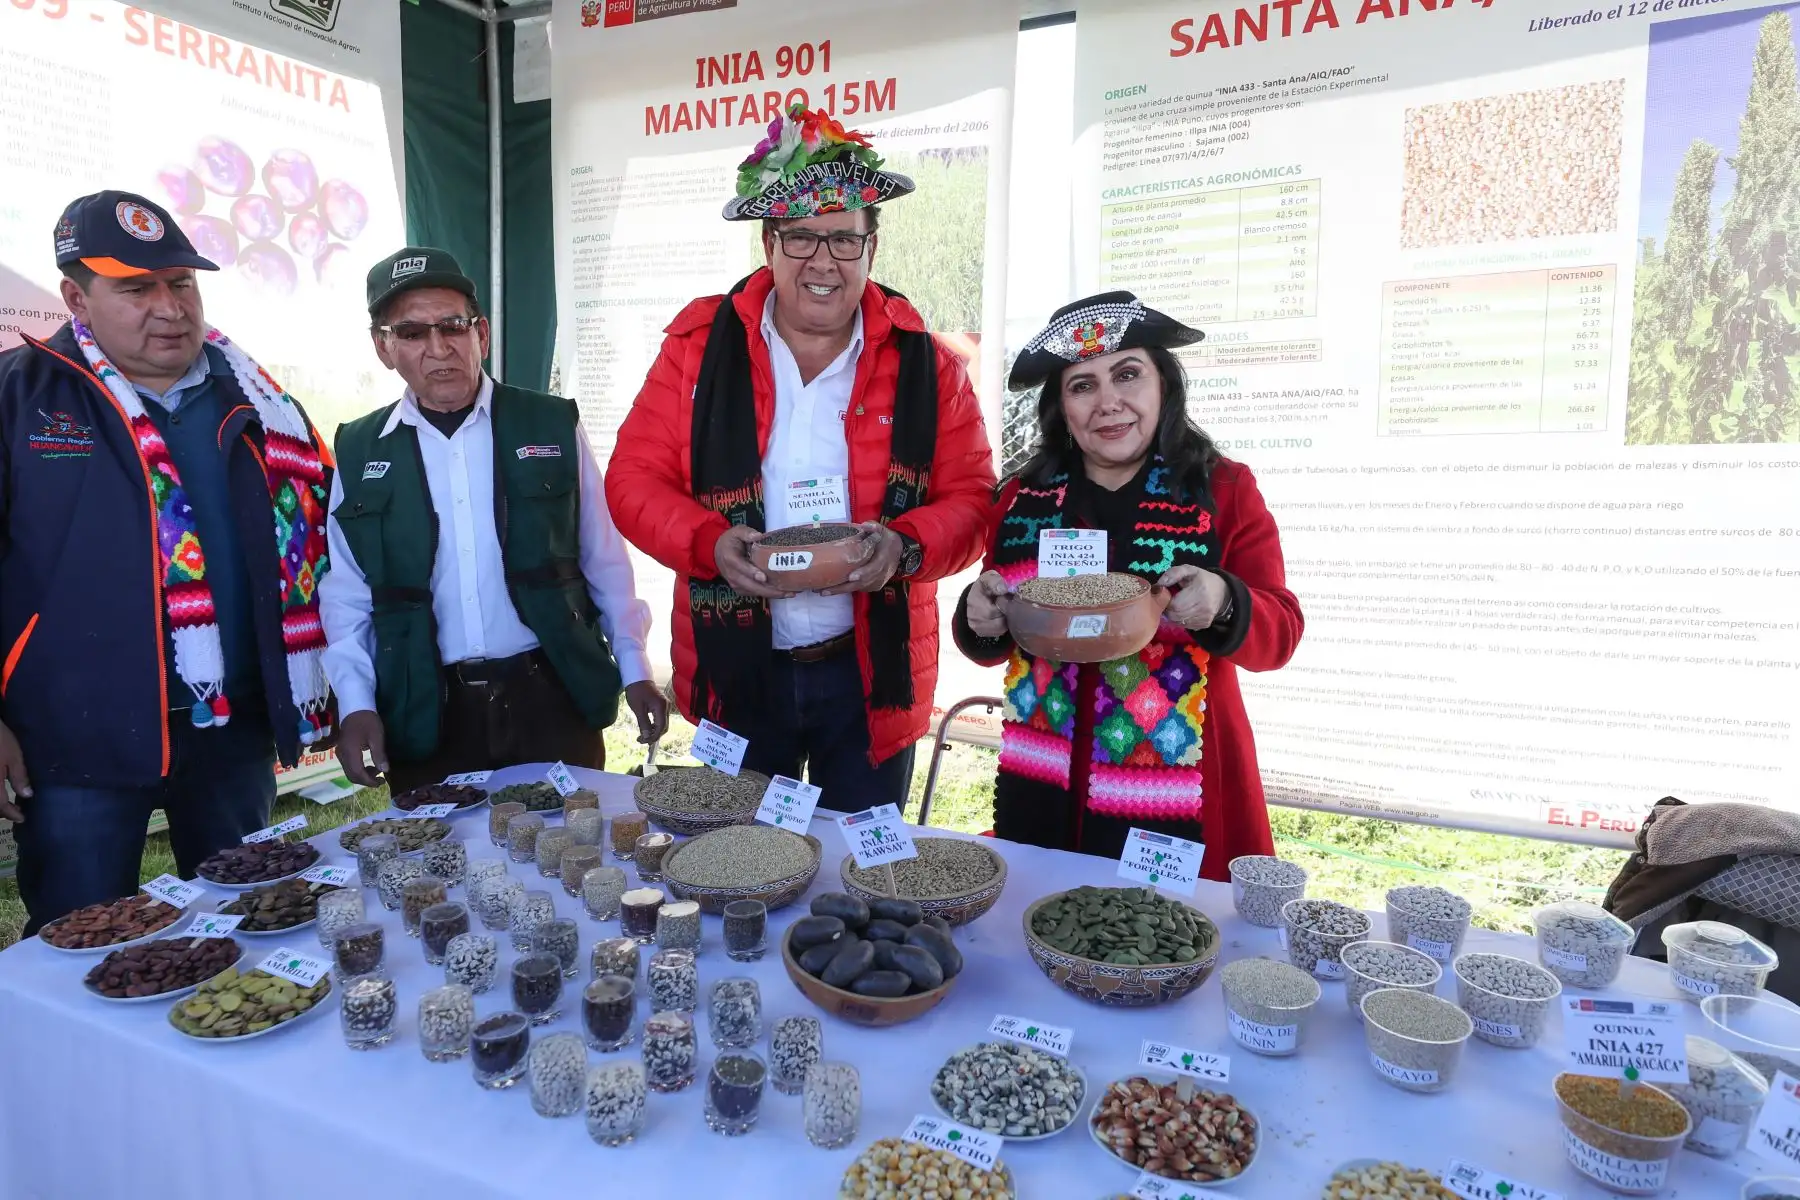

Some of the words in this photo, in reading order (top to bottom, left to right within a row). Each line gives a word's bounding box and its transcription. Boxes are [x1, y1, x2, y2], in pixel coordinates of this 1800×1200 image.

[637, 6, 648, 16] de
[649, 1, 691, 14] Agricultura
[1529, 9, 1603, 32] Liberado
[1607, 5, 1621, 20] el
[1626, 1, 1649, 17] 12
[1653, 0, 1674, 12] de
[263, 10, 293, 28] Nacional
[293, 23, 302, 32] de
[303, 26, 338, 46] Innovación
[338, 39, 361, 54] Agraria
[1169, 0, 1340, 58] SANTA
[123, 6, 351, 114] SERRANITA
[696, 50, 764, 89] INIA
[775, 40, 832, 79] 901
[1103, 114, 1136, 126] proviene
[1138, 112, 1147, 121] de
[1149, 110, 1164, 118] una
[1166, 106, 1187, 116] cruza
[1188, 102, 1215, 112] simple
[1216, 94, 1266, 108] proveniente
[1268, 91, 1279, 100] de
[1281, 89, 1289, 98] la
[1291, 84, 1327, 96] Estación
[1329, 74, 1389, 90] Experimental
[1104, 83, 1148, 101] ORIGEN
[1114, 103, 1137, 113] nueva
[1138, 96, 1172, 108] variedad
[1173, 95, 1183, 103] de
[1185, 91, 1213, 101] quinua
[1239, 82, 1255, 91] 433
[1262, 78, 1287, 88] Santa
[644, 87, 809, 136] MANTARO
[823, 77, 897, 117] 15M
[876, 128, 889, 139] de
[890, 123, 941, 138] diciembre
[943, 121, 960, 134] del
[961, 120, 990, 133] 2006
[1103, 137, 1143, 148] Progenitor
[1144, 131, 1183, 142] femenino
[1208, 123, 1227, 132] INIA
[1228, 119, 1251, 130] (004)
[1103, 148, 1142, 160] Progenitor
[1144, 142, 1184, 153] masculino
[1195, 136, 1225, 146] Sajama
[1227, 131, 1249, 143] (002)
[571, 165, 594, 176] ORIGEN
[1102, 161, 1137, 171] Pedigree:
[1101, 177, 1203, 199] CARACTERÍSTICAS
[1206, 165, 1302, 184] AGRONÓMICAS
[1243, 226, 1271, 234] Blanco
[1272, 222, 1307, 231] cremoso
[396, 258, 423, 271] inia
[1550, 270, 1603, 281] CONTENIDO
[1394, 282, 1450, 292] COMPONENTE
[0, 307, 16, 316] so
[19, 308, 41, 319] con
[1216, 345, 1278, 354] Moderadamente
[1280, 343, 1316, 351] tolerante
[1216, 356, 1278, 364] Moderadamente
[1280, 353, 1317, 362] Tolerante
[1207, 393, 1225, 401] INIA
[1226, 392, 1242, 400] 433
[1251, 391, 1278, 400] SANTA
[29, 434, 65, 444] Gobierno
[1235, 439, 1254, 449] DEL
[1259, 438, 1312, 448] CULTIVO
[1502, 464, 1548, 472] disminuir
[1552, 462, 1560, 471] la
[1564, 463, 1614, 472] población
[1635, 461, 1677, 470] malezas
[1692, 461, 1742, 469] disminuir
[1747, 459, 1763, 469] los
[792, 490, 835, 499] SEMILLA
[788, 499, 812, 511] VICIA
[812, 496, 842, 509] SATIVA
[1051, 543, 1093, 551] TRIGO
[1050, 552, 1077, 560] INIA
[1078, 552, 1095, 560] 424
[705, 736, 733, 753] AVENA
[774, 792, 802, 807] QUUA
[860, 824, 891, 838] PAPA
[861, 836, 884, 850] INIA
[883, 832, 899, 844] 321
[858, 840, 907, 860] "KAWSAY"
[1140, 847, 1183, 864] HABA
[1123, 860, 1193, 884] "FORTALEZA"
[1140, 856, 1161, 868] INIA
[1162, 862, 1179, 872] 416
[303, 873, 345, 884] MOTEADA
[264, 959, 316, 982] AMARILLA
[1593, 1023, 1656, 1037] QUINUA
[1588, 1038, 1631, 1054] INIA
[1635, 1043, 1665, 1057] 427
[1147, 1057, 1228, 1079] PARO
[910, 1130, 993, 1164] MOROCHO
